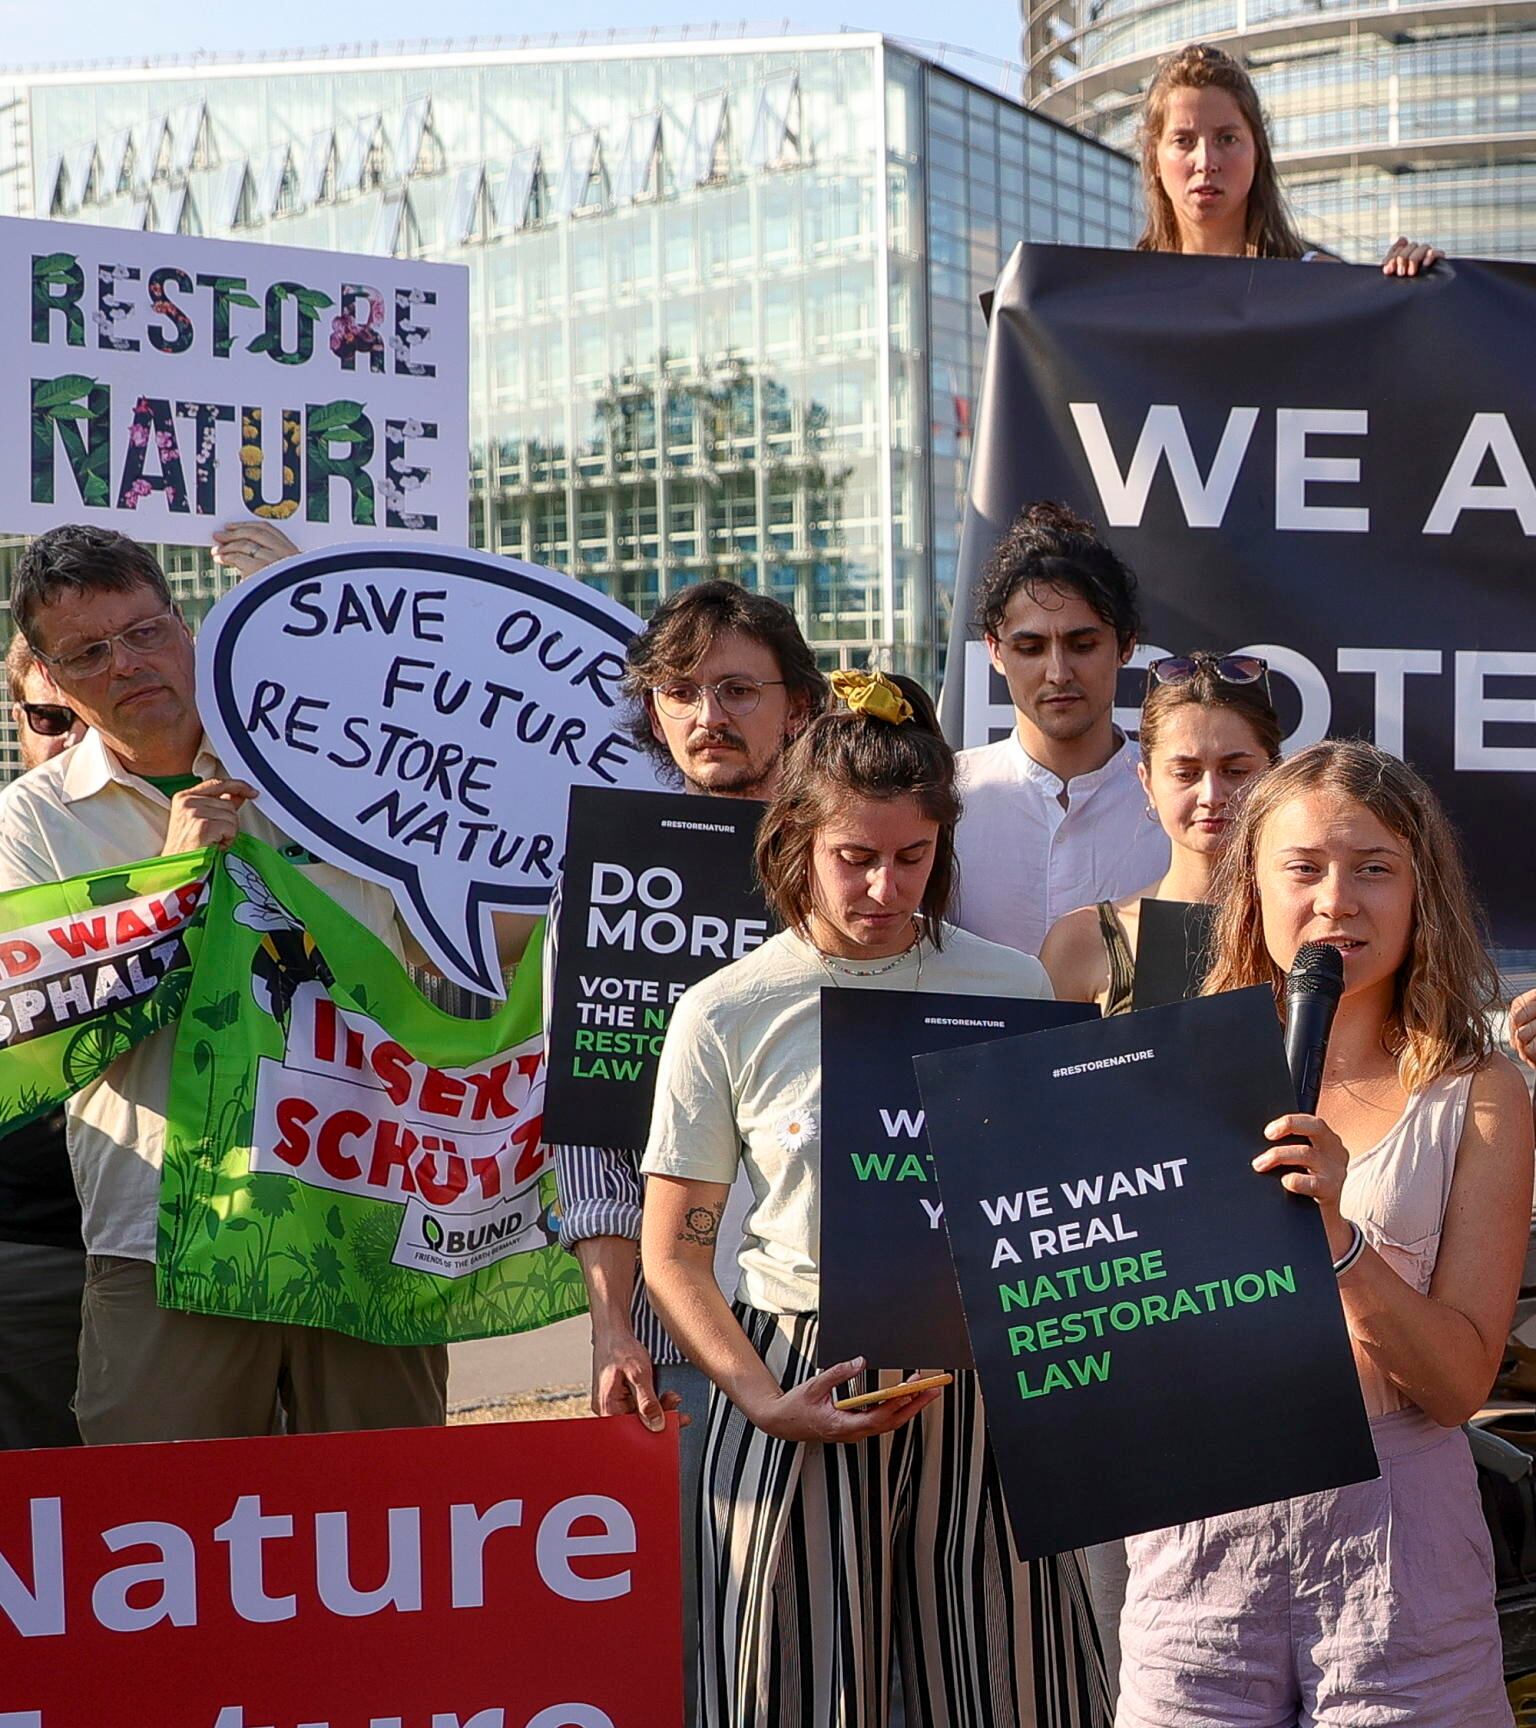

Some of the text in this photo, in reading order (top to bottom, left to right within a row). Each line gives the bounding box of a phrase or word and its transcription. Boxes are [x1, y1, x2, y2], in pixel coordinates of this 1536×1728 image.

[31, 252, 437, 378] RESTORE
[30, 373, 438, 531] NATURE
[1069, 402, 1370, 533] WE
[282, 582, 627, 707] SAVE OUR
[247, 679, 498, 816] RESTORE
[382, 656, 641, 784] FUTURE
[356, 789, 566, 879] NATUR
[660, 819, 736, 834] #RESTORENATURE
[590, 862, 683, 909] DO
[586, 906, 768, 960] MORE
[577, 1002, 635, 1027] THE
[579, 975, 690, 1003] VOTE F
[924, 1017, 1006, 1029] #RESTORENATURE
[572, 1056, 643, 1081] LAW
[1052, 1048, 1155, 1079] #RESTORENATURE
[272, 1097, 553, 1205] SCHÜTZ
[850, 1153, 938, 1182] WA
[980, 1158, 1189, 1227] WE WANT
[446, 1212, 523, 1253] BUND
[990, 1212, 1138, 1269] A REAL
[454, 1258, 468, 1269] THE
[998, 1249, 1168, 1313] NATURE
[1007, 1265, 1297, 1357] RESTORATION
[1016, 1350, 1112, 1401] LAW
[0, 1494, 638, 1639] Nature
